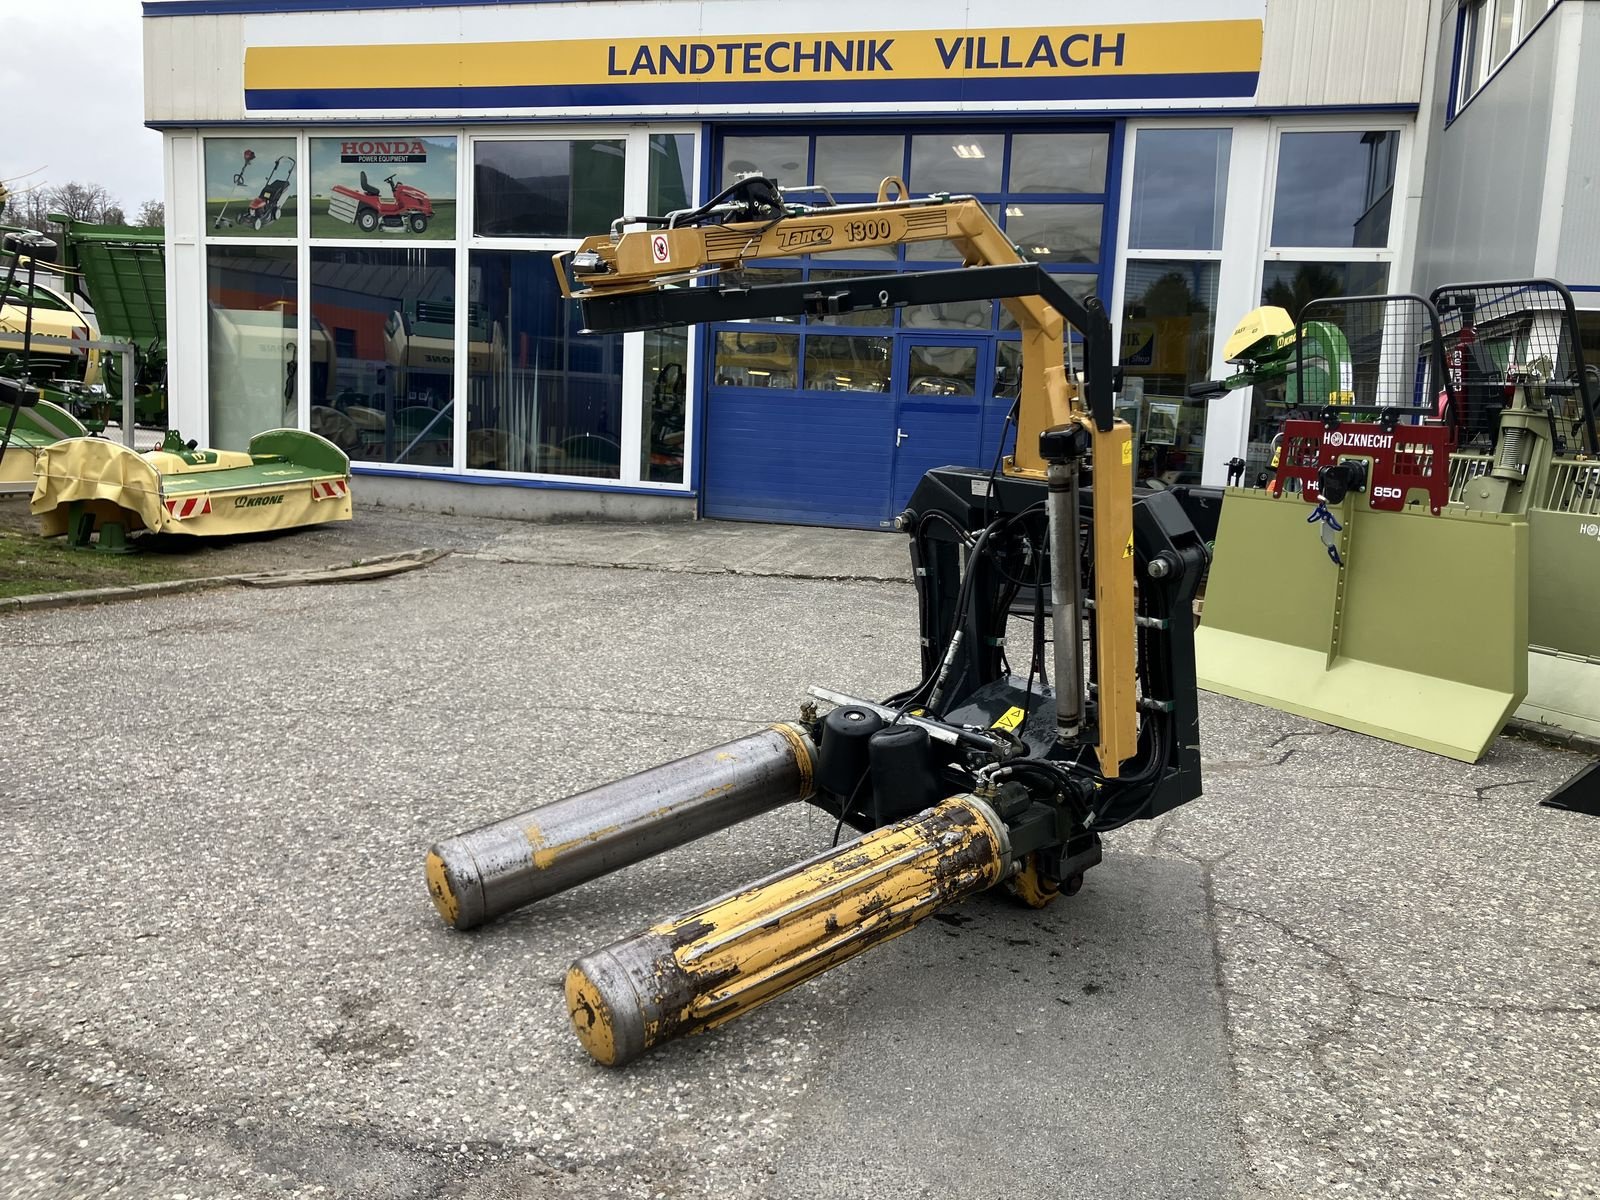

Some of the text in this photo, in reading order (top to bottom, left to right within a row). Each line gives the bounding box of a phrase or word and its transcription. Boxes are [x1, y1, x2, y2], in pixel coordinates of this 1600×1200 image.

[607, 33, 1126, 76] LANDTECHNIK VILLACH
[341, 141, 427, 155] HONDA
[358, 155, 409, 163] POWER EQUIPMENT
[776, 218, 891, 252] Tanco 1300
[1323, 431, 1394, 449] HOLZKNECHT
[1373, 486, 1402, 499] 850
[247, 494, 285, 508] KRONE
